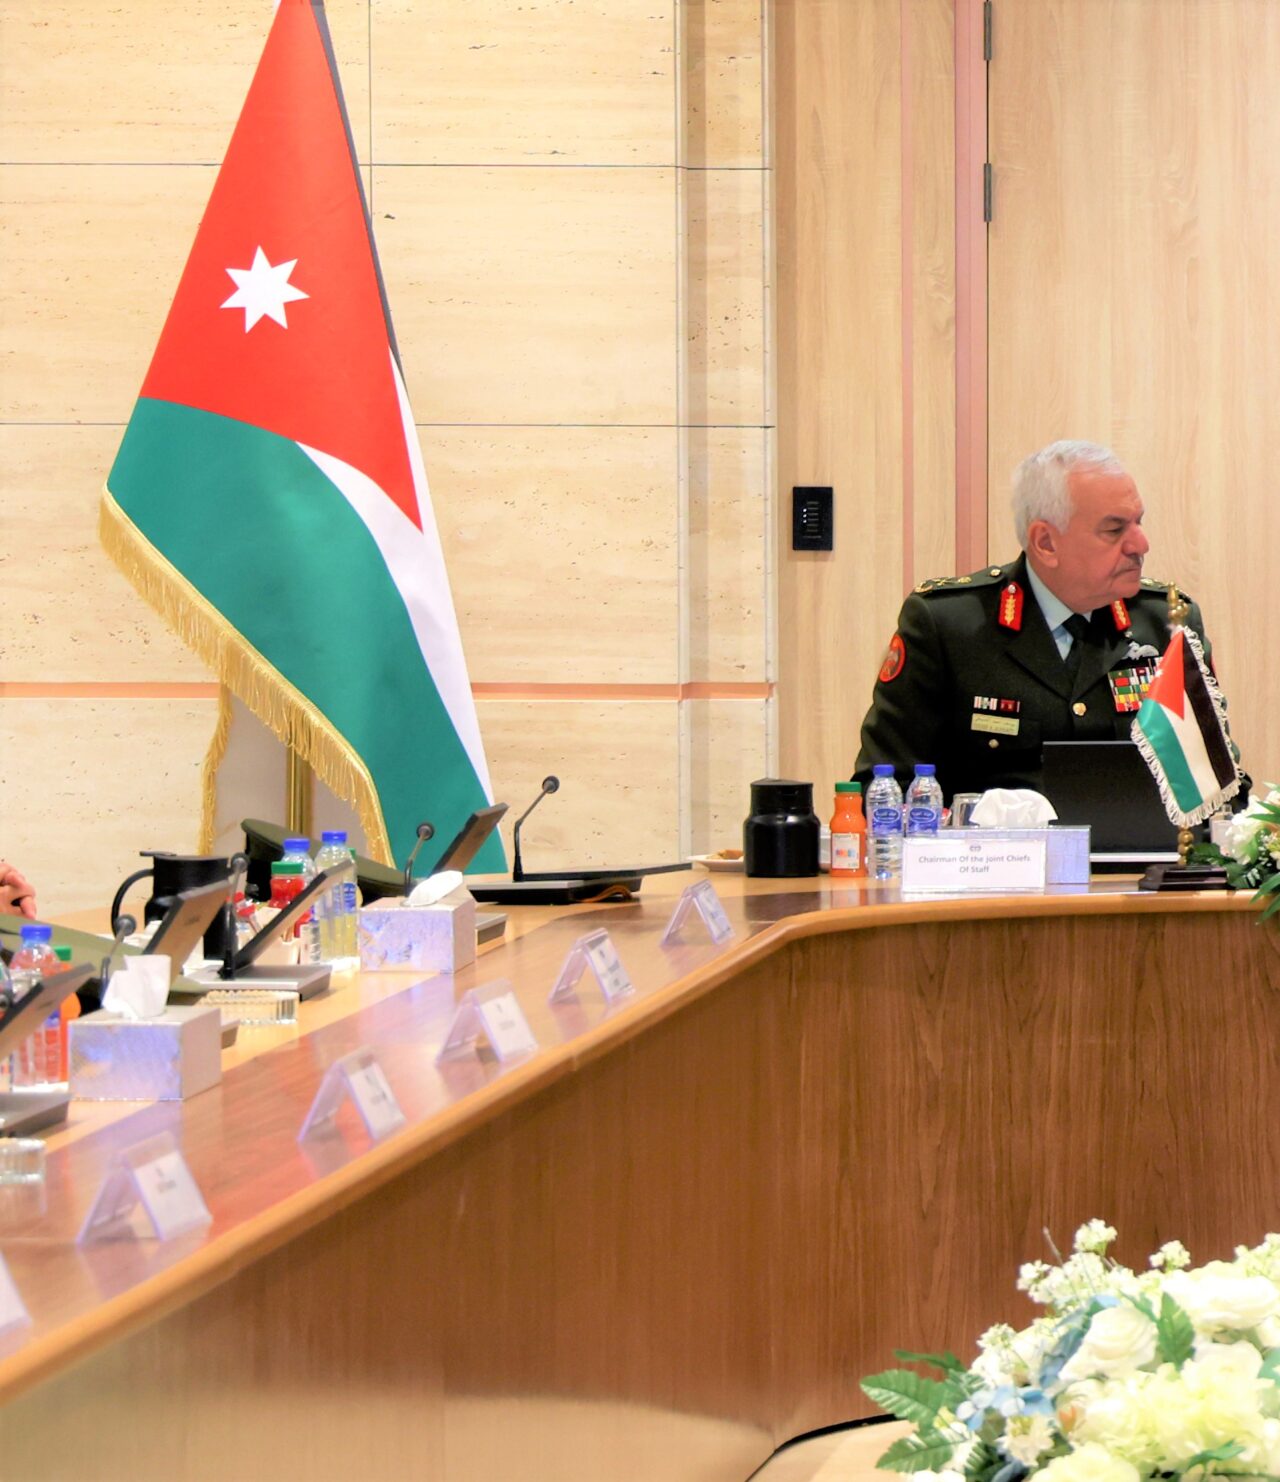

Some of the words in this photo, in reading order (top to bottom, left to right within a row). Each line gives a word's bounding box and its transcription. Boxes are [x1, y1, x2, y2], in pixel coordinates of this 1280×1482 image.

[918, 855, 957, 863] Chairman
[959, 855, 969, 863] Of
[1006, 854, 1031, 862] Chiefs
[959, 865, 969, 873] Of
[971, 865, 990, 873] Staff
